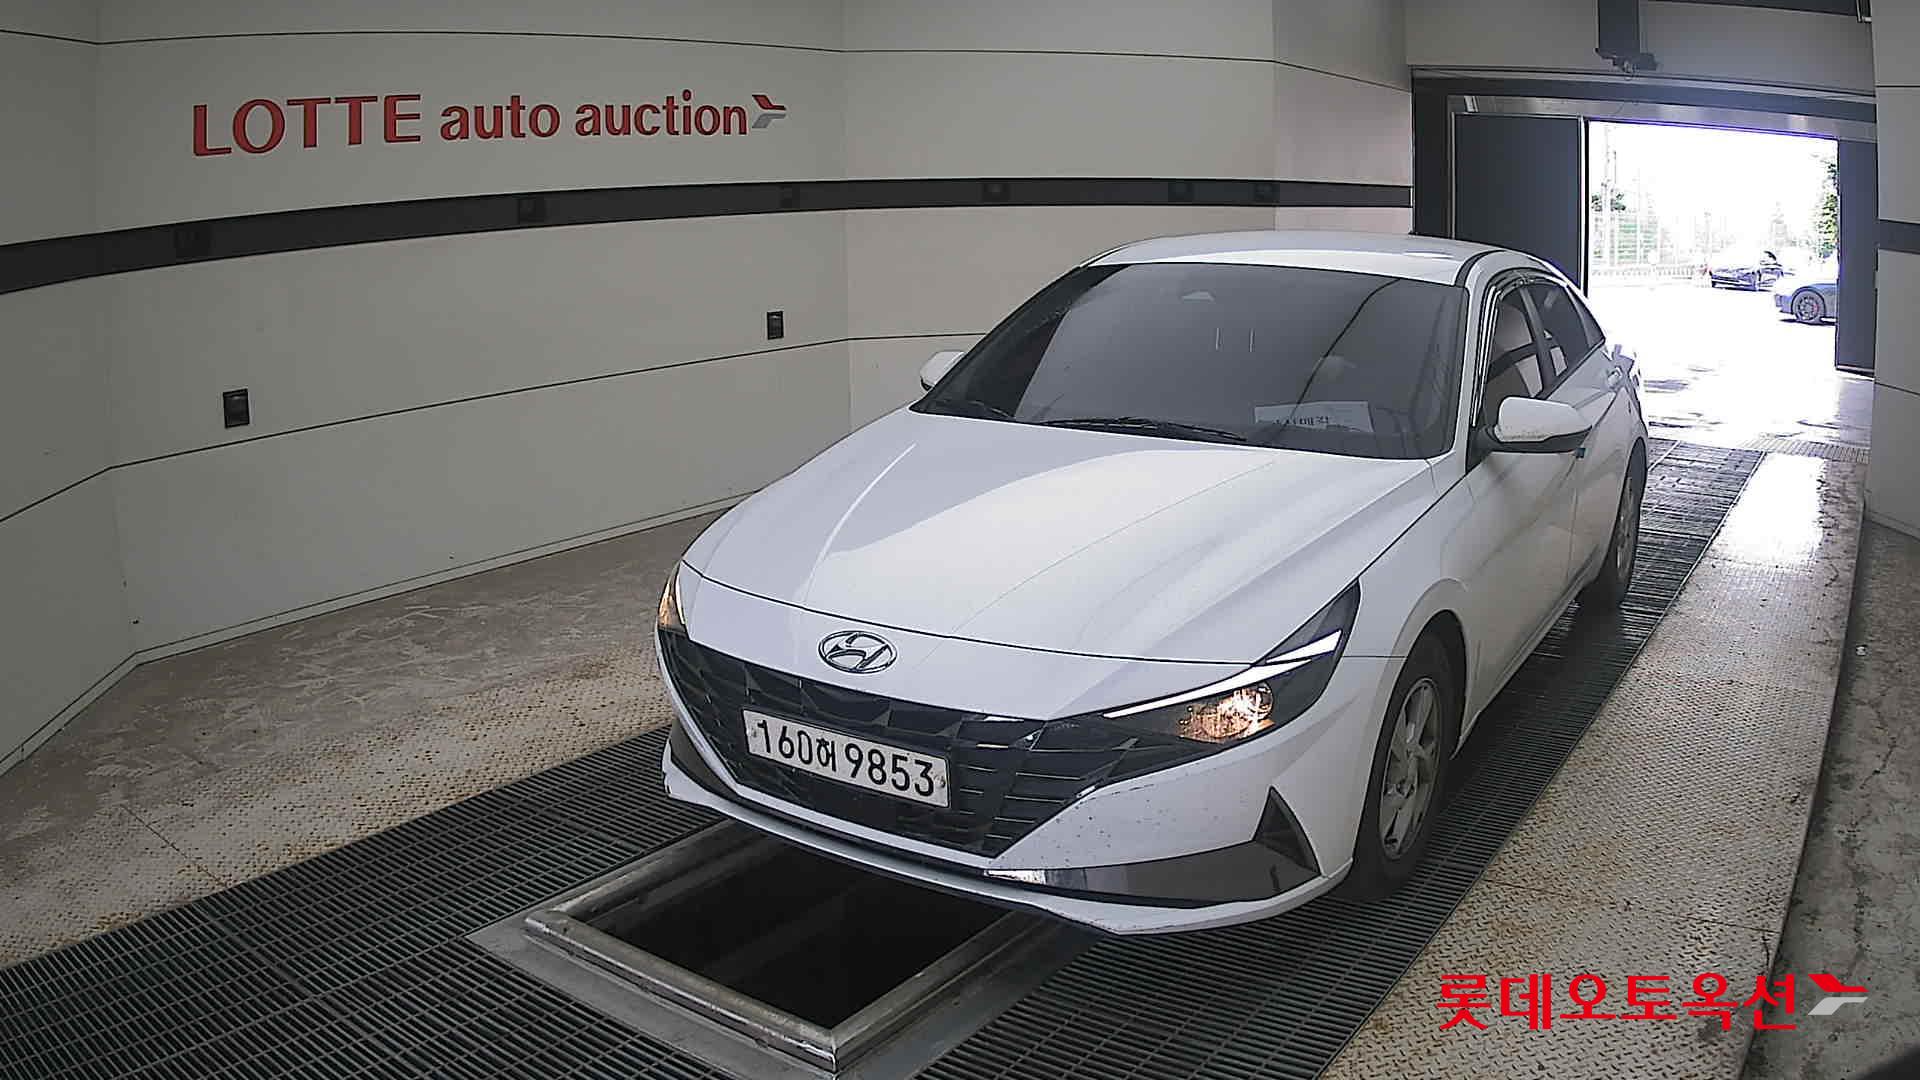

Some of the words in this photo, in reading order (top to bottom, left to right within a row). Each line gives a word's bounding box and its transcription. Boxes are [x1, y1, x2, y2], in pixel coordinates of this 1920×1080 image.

[193, 94, 421, 157] LOTTE
[439, 95, 561, 141] auto
[575, 89, 748, 136] auction
